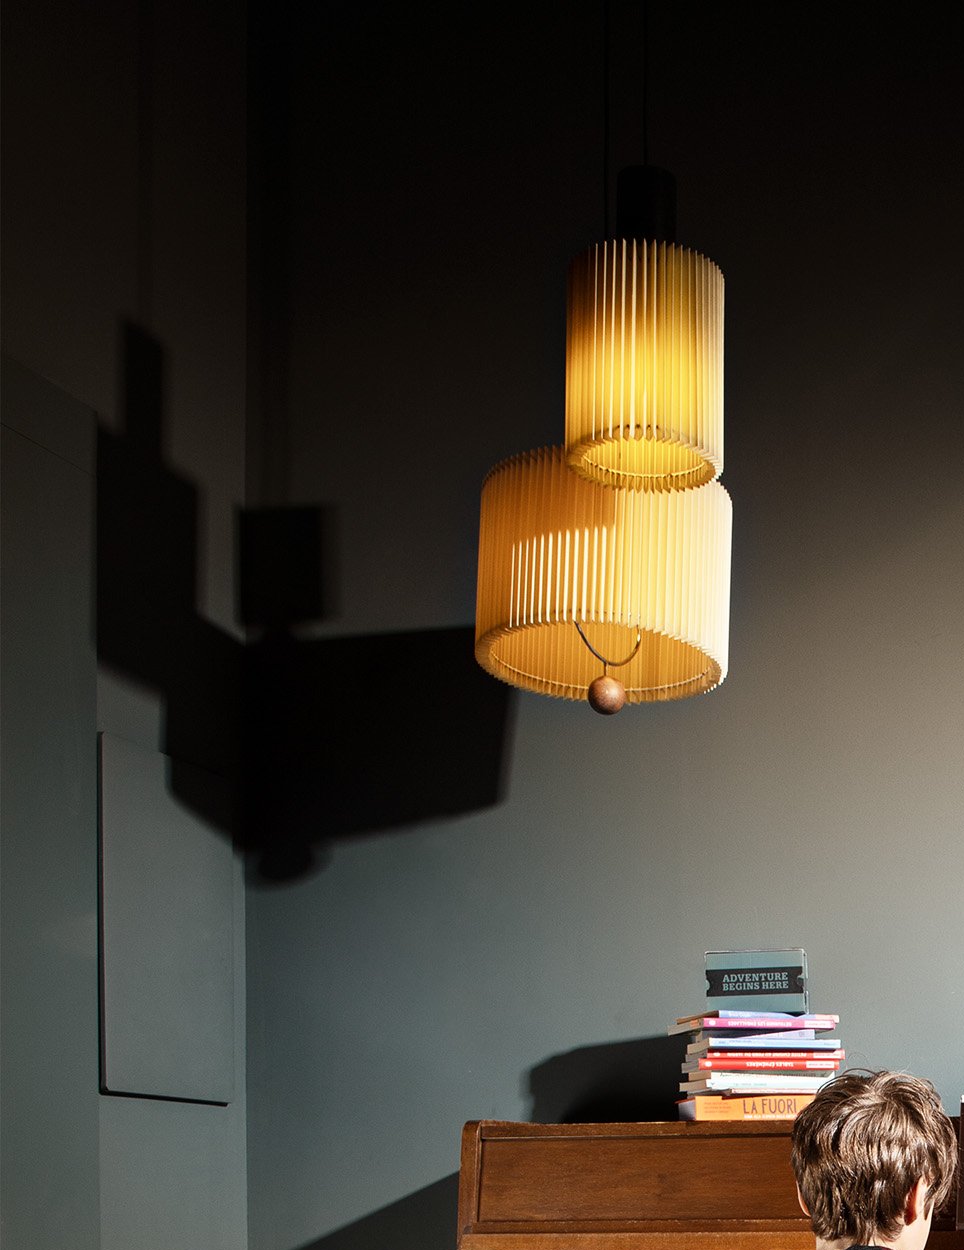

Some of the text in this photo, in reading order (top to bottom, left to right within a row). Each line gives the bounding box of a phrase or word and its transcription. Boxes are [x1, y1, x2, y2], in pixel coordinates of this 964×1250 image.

[722, 972, 789, 983] ADVENTURE
[722, 980, 789, 992] BEGINS HERE
[761, 1098, 797, 1114] FUORI
